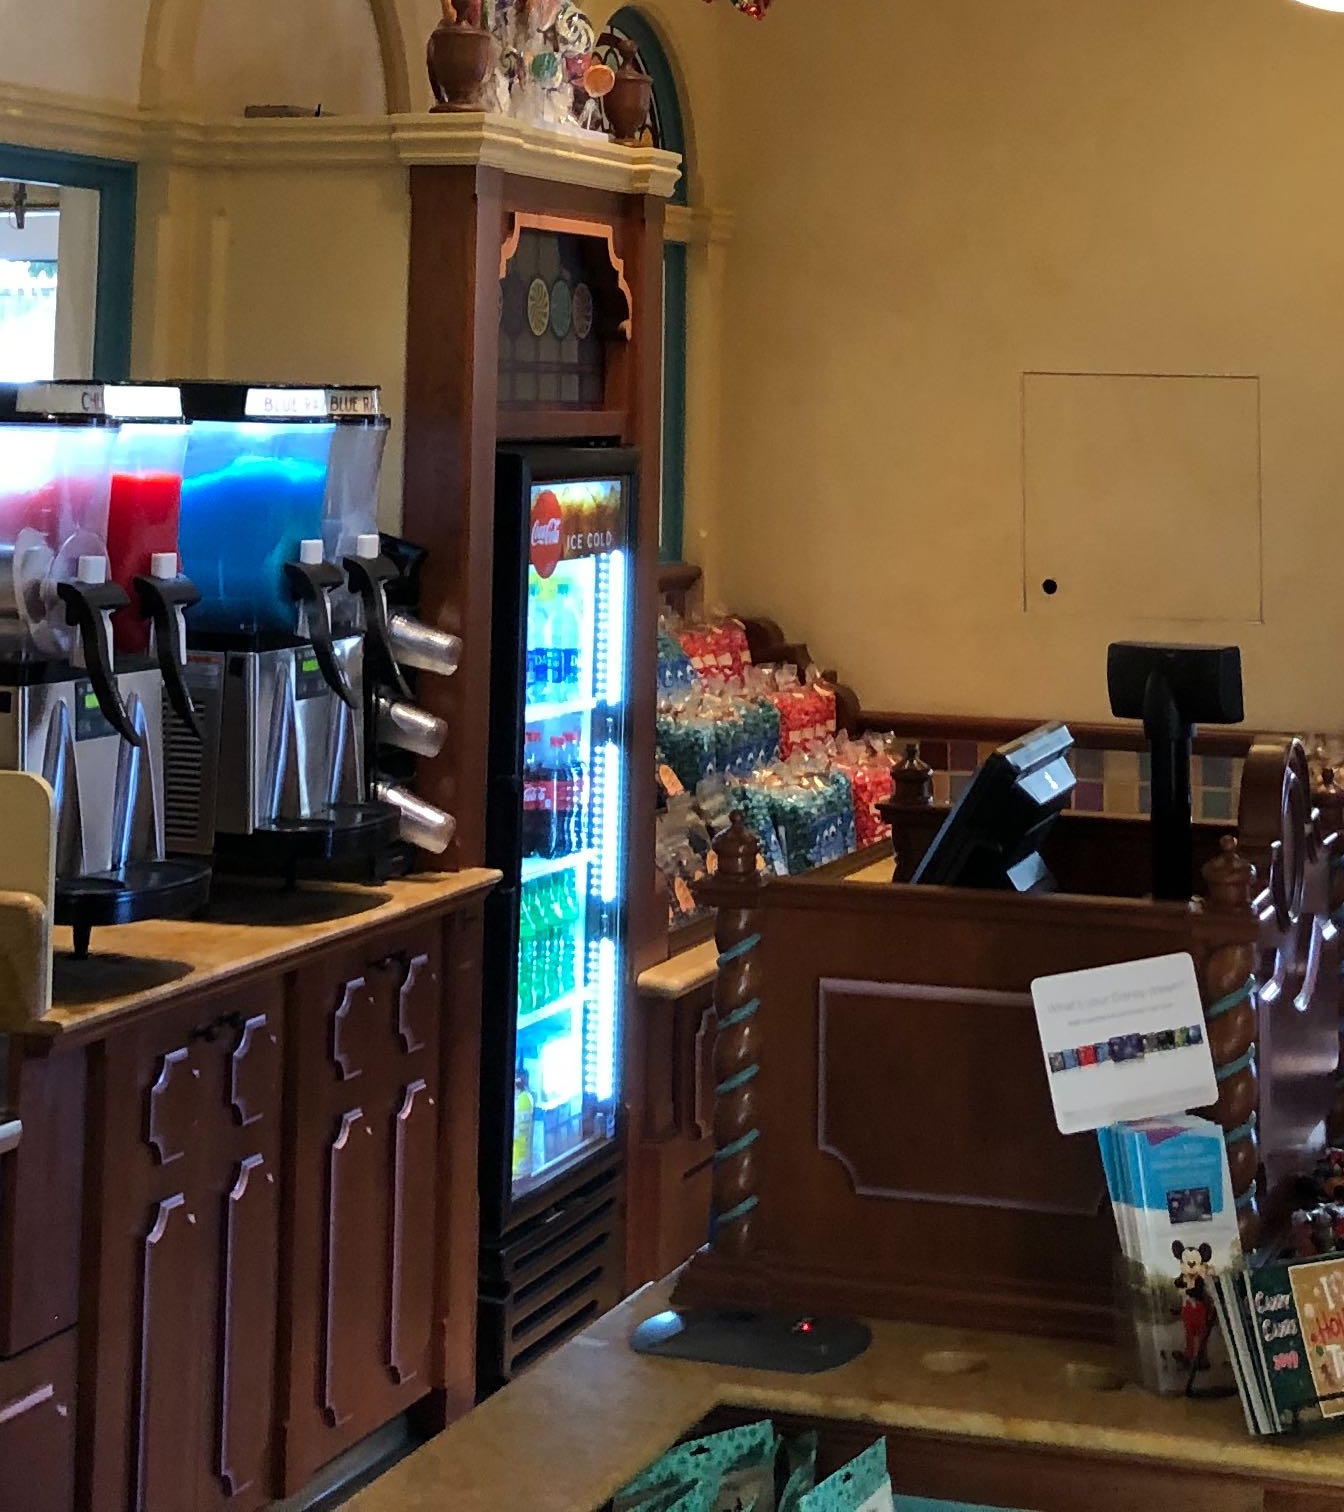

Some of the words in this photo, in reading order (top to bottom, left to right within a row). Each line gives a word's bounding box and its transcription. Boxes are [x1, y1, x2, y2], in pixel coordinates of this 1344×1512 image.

[330, 395, 359, 413] BLUE
[567, 533, 584, 550] ICE
[586, 530, 613, 549] COLD
